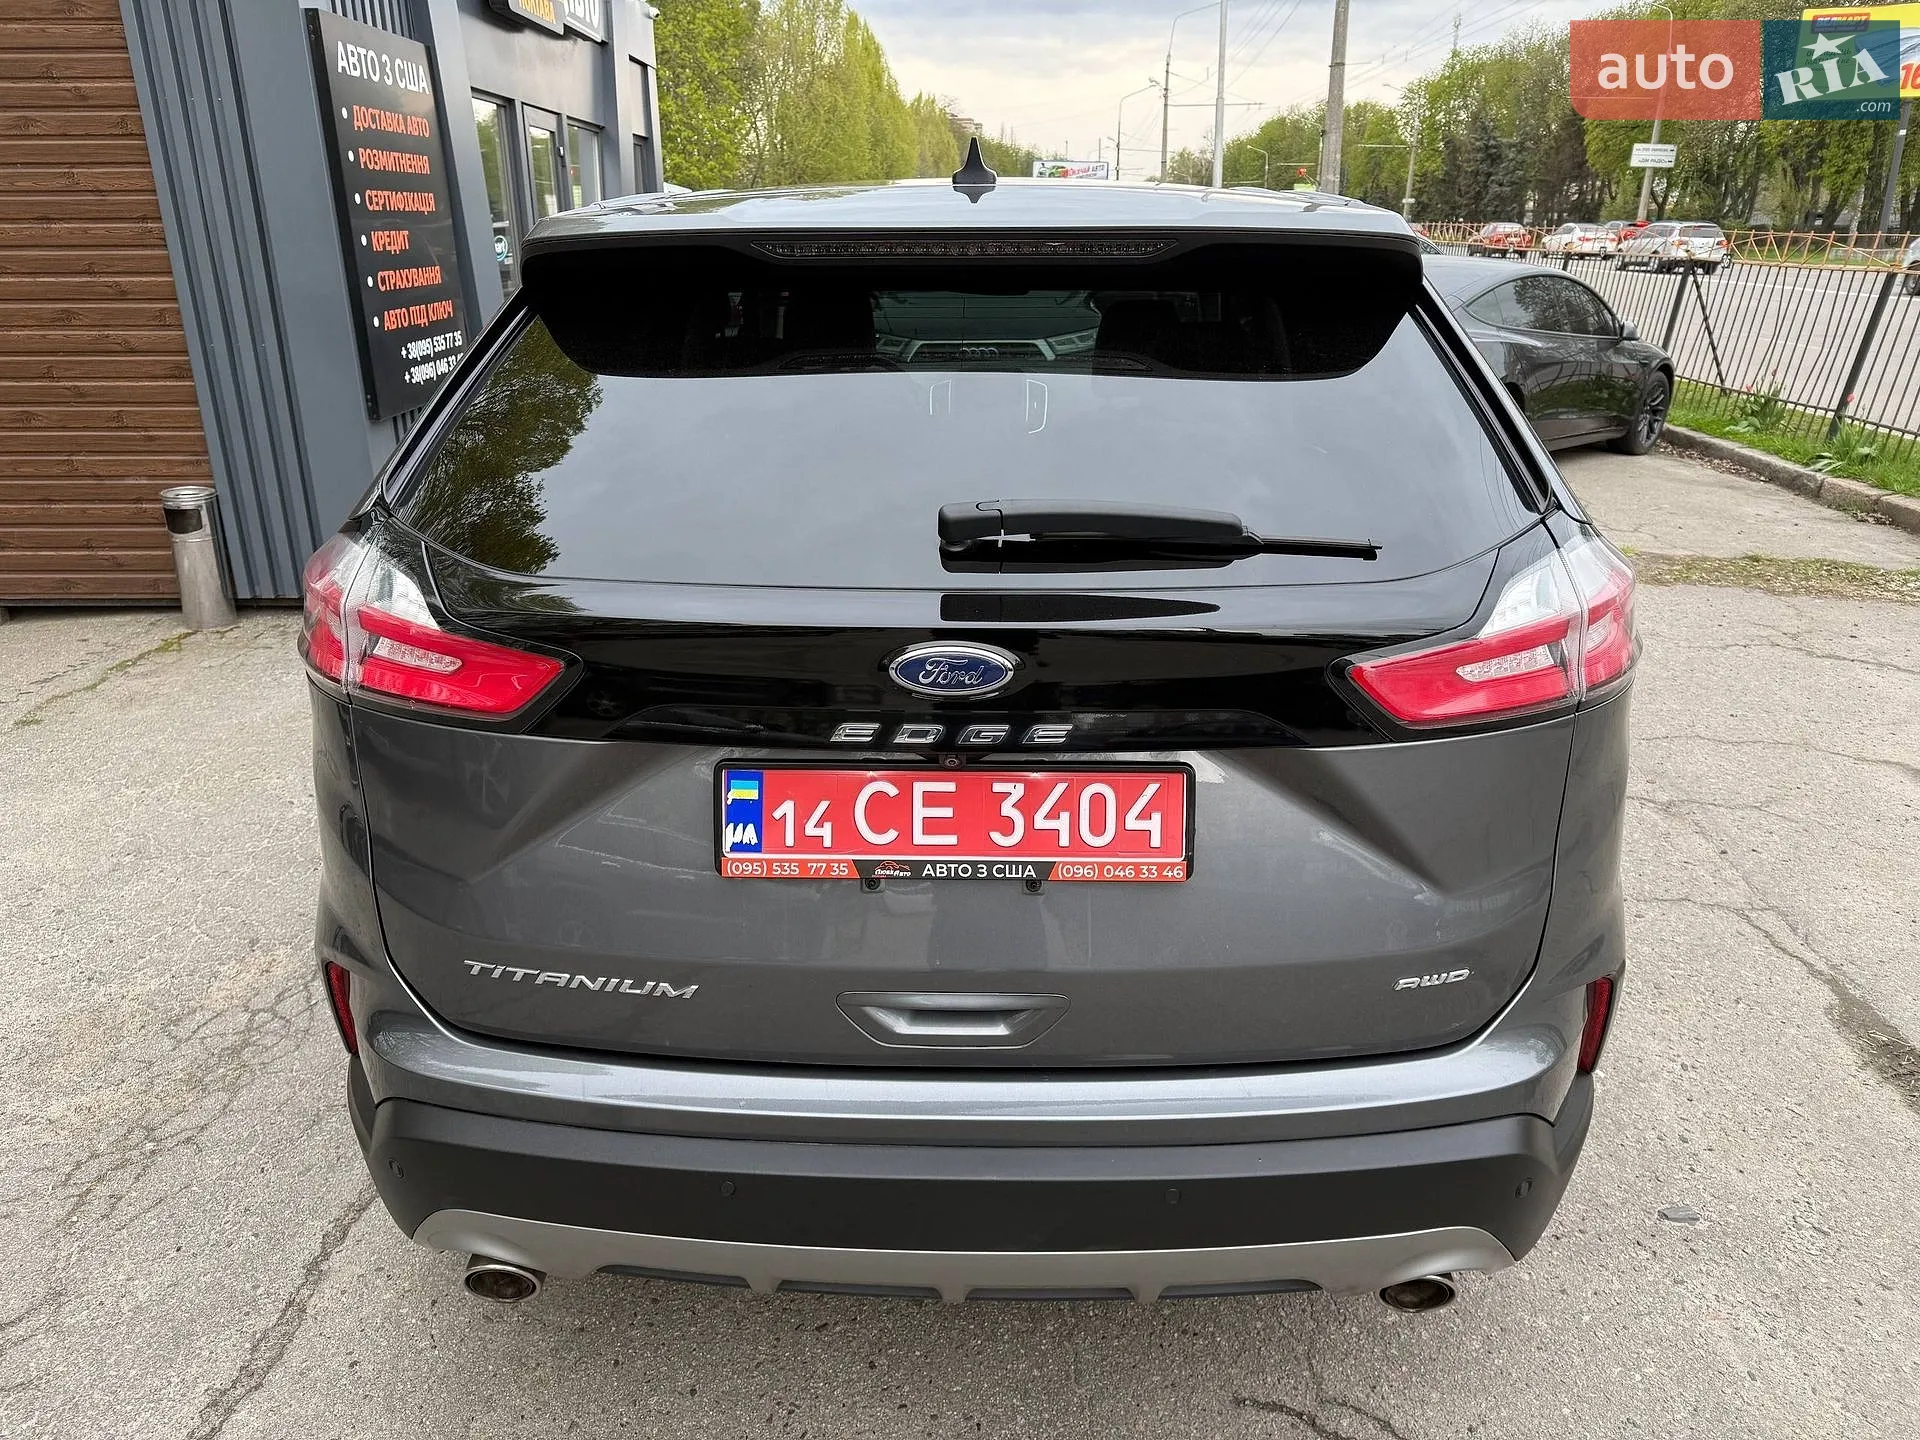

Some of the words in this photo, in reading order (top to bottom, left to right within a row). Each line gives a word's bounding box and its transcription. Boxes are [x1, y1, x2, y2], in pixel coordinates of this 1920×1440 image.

[338, 41, 380, 82] АВТО
[395, 58, 430, 95] США
[353, 105, 406, 134] ДОСТАВКА
[407, 115, 430, 138] АВТО
[358, 147, 431, 174] РОЗМИТНЕННЯ
[365, 189, 436, 215] СЕРТИФІКАЦІЯ
[370, 230, 409, 255] КРЕДИТ
[377, 266, 442, 291] СТРАХУВАННЯ
[384, 308, 409, 331] АВТО
[409, 303, 429, 327] ПІД
[428, 300, 453, 321] КЛЮЧ
[445, 332, 454, 348] 77
[454, 330, 463, 346] 35
[919, 657, 985, 685] Ford
[829, 723, 1074, 745] EDGE
[772, 800, 832, 848] 14
[989, 782, 1162, 848] 3404
[727, 862, 767, 877] (095)
[772, 862, 799, 875] 535
[808, 863, 826, 875] 77
[830, 863, 849, 876] 35
[922, 864, 971, 877] АВТО
[993, 864, 1037, 878] США
[1058, 864, 1098, 879] (096)
[1104, 865, 1135, 878] 046
[1139, 866, 1158, 878] 33
[1162, 866, 1184, 878] 46
[464, 959, 700, 999] TITANIUM
[1393, 969, 1470, 991] AWD
